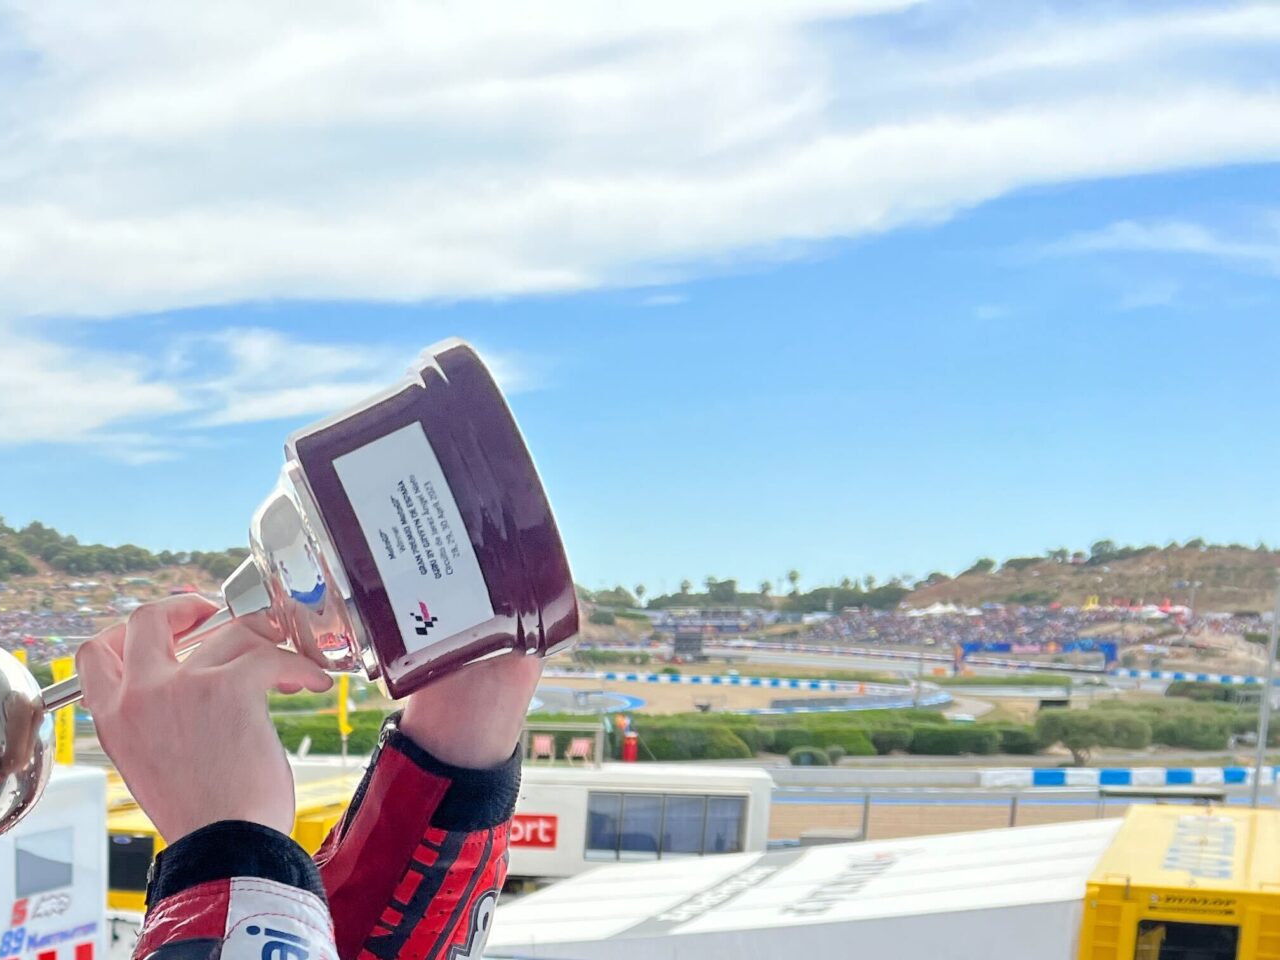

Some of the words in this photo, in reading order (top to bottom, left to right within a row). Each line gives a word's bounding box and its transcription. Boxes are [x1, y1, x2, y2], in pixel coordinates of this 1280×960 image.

[409, 508, 417, 518] DE
[403, 525, 419, 554] PREMIO
[434, 536, 442, 546] de
[415, 554, 427, 575] GRAN
[510, 820, 552, 843] ort
